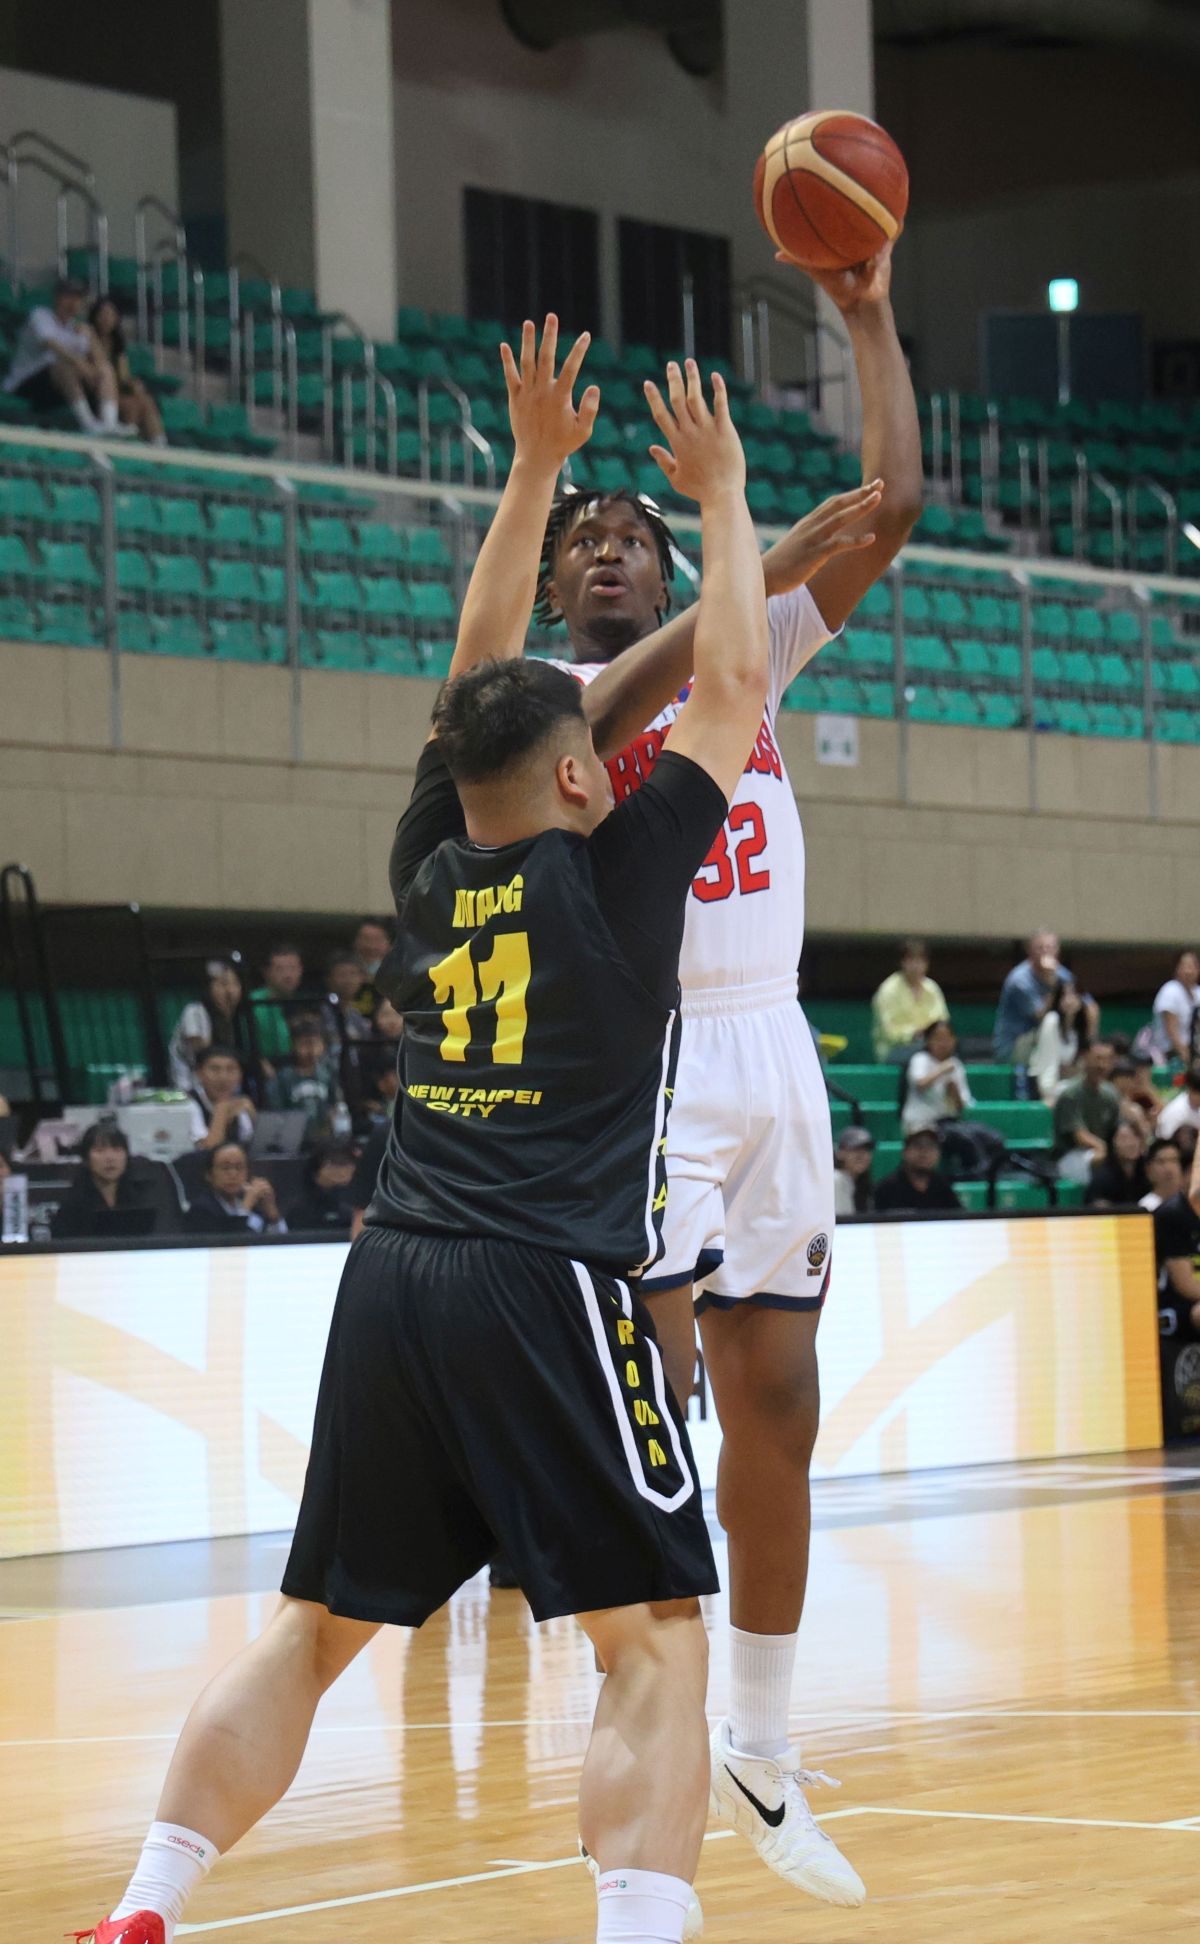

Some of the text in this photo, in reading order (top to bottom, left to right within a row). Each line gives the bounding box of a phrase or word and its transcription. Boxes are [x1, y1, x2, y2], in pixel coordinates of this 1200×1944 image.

[692, 801, 770, 903] 32
[428, 931, 531, 1065] 11
[408, 1084, 542, 1105] NEW TAIPEI
[426, 1101, 497, 1118] CITY
